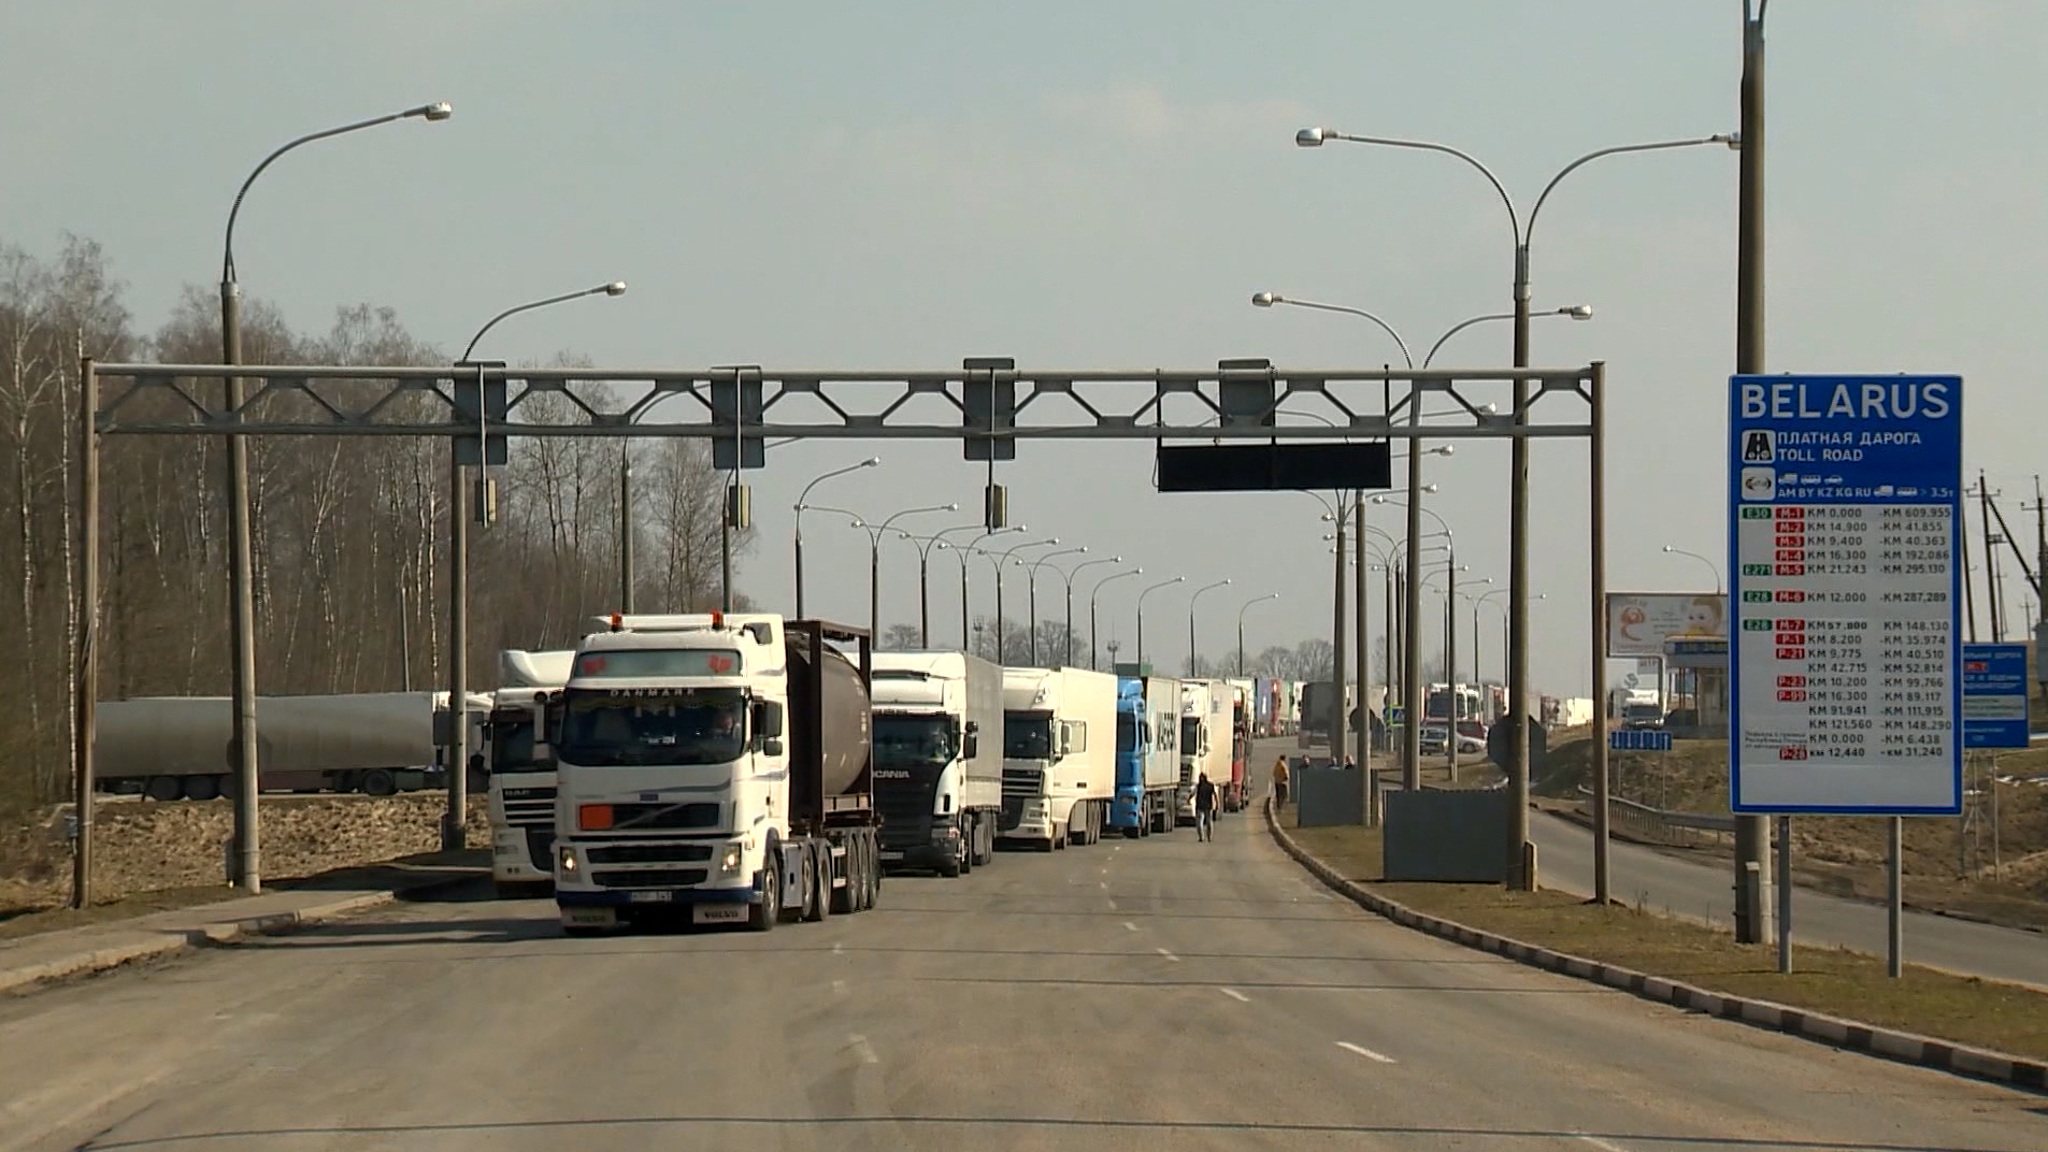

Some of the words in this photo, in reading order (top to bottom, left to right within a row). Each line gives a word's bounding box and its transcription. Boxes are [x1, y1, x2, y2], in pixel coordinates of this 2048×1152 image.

[1741, 383, 1949, 419] BELARUS
[1778, 432, 1853, 445] ПЛАТНАЯ
[1859, 432, 1921, 445] ДАРОГА
[1778, 449, 1815, 461] TOLL
[1822, 449, 1864, 461] ROAD
[1778, 488, 1797, 497] AM
[1798, 488, 1814, 497] BY
[1817, 488, 1833, 497] KZ
[1836, 488, 1853, 497] KG
[1855, 488, 1872, 497] RU
[1830, 508, 1861, 517] 0.000
[1905, 508, 1950, 517] 609.955
[1830, 523, 1867, 531] 14.900
[1905, 523, 1942, 531] 41.855
[1830, 537, 1862, 545] 9.400
[1830, 635, 1861, 644] 8.200
[1831, 735, 1863, 744] 0.000
[874, 770, 910, 778] CANIA
